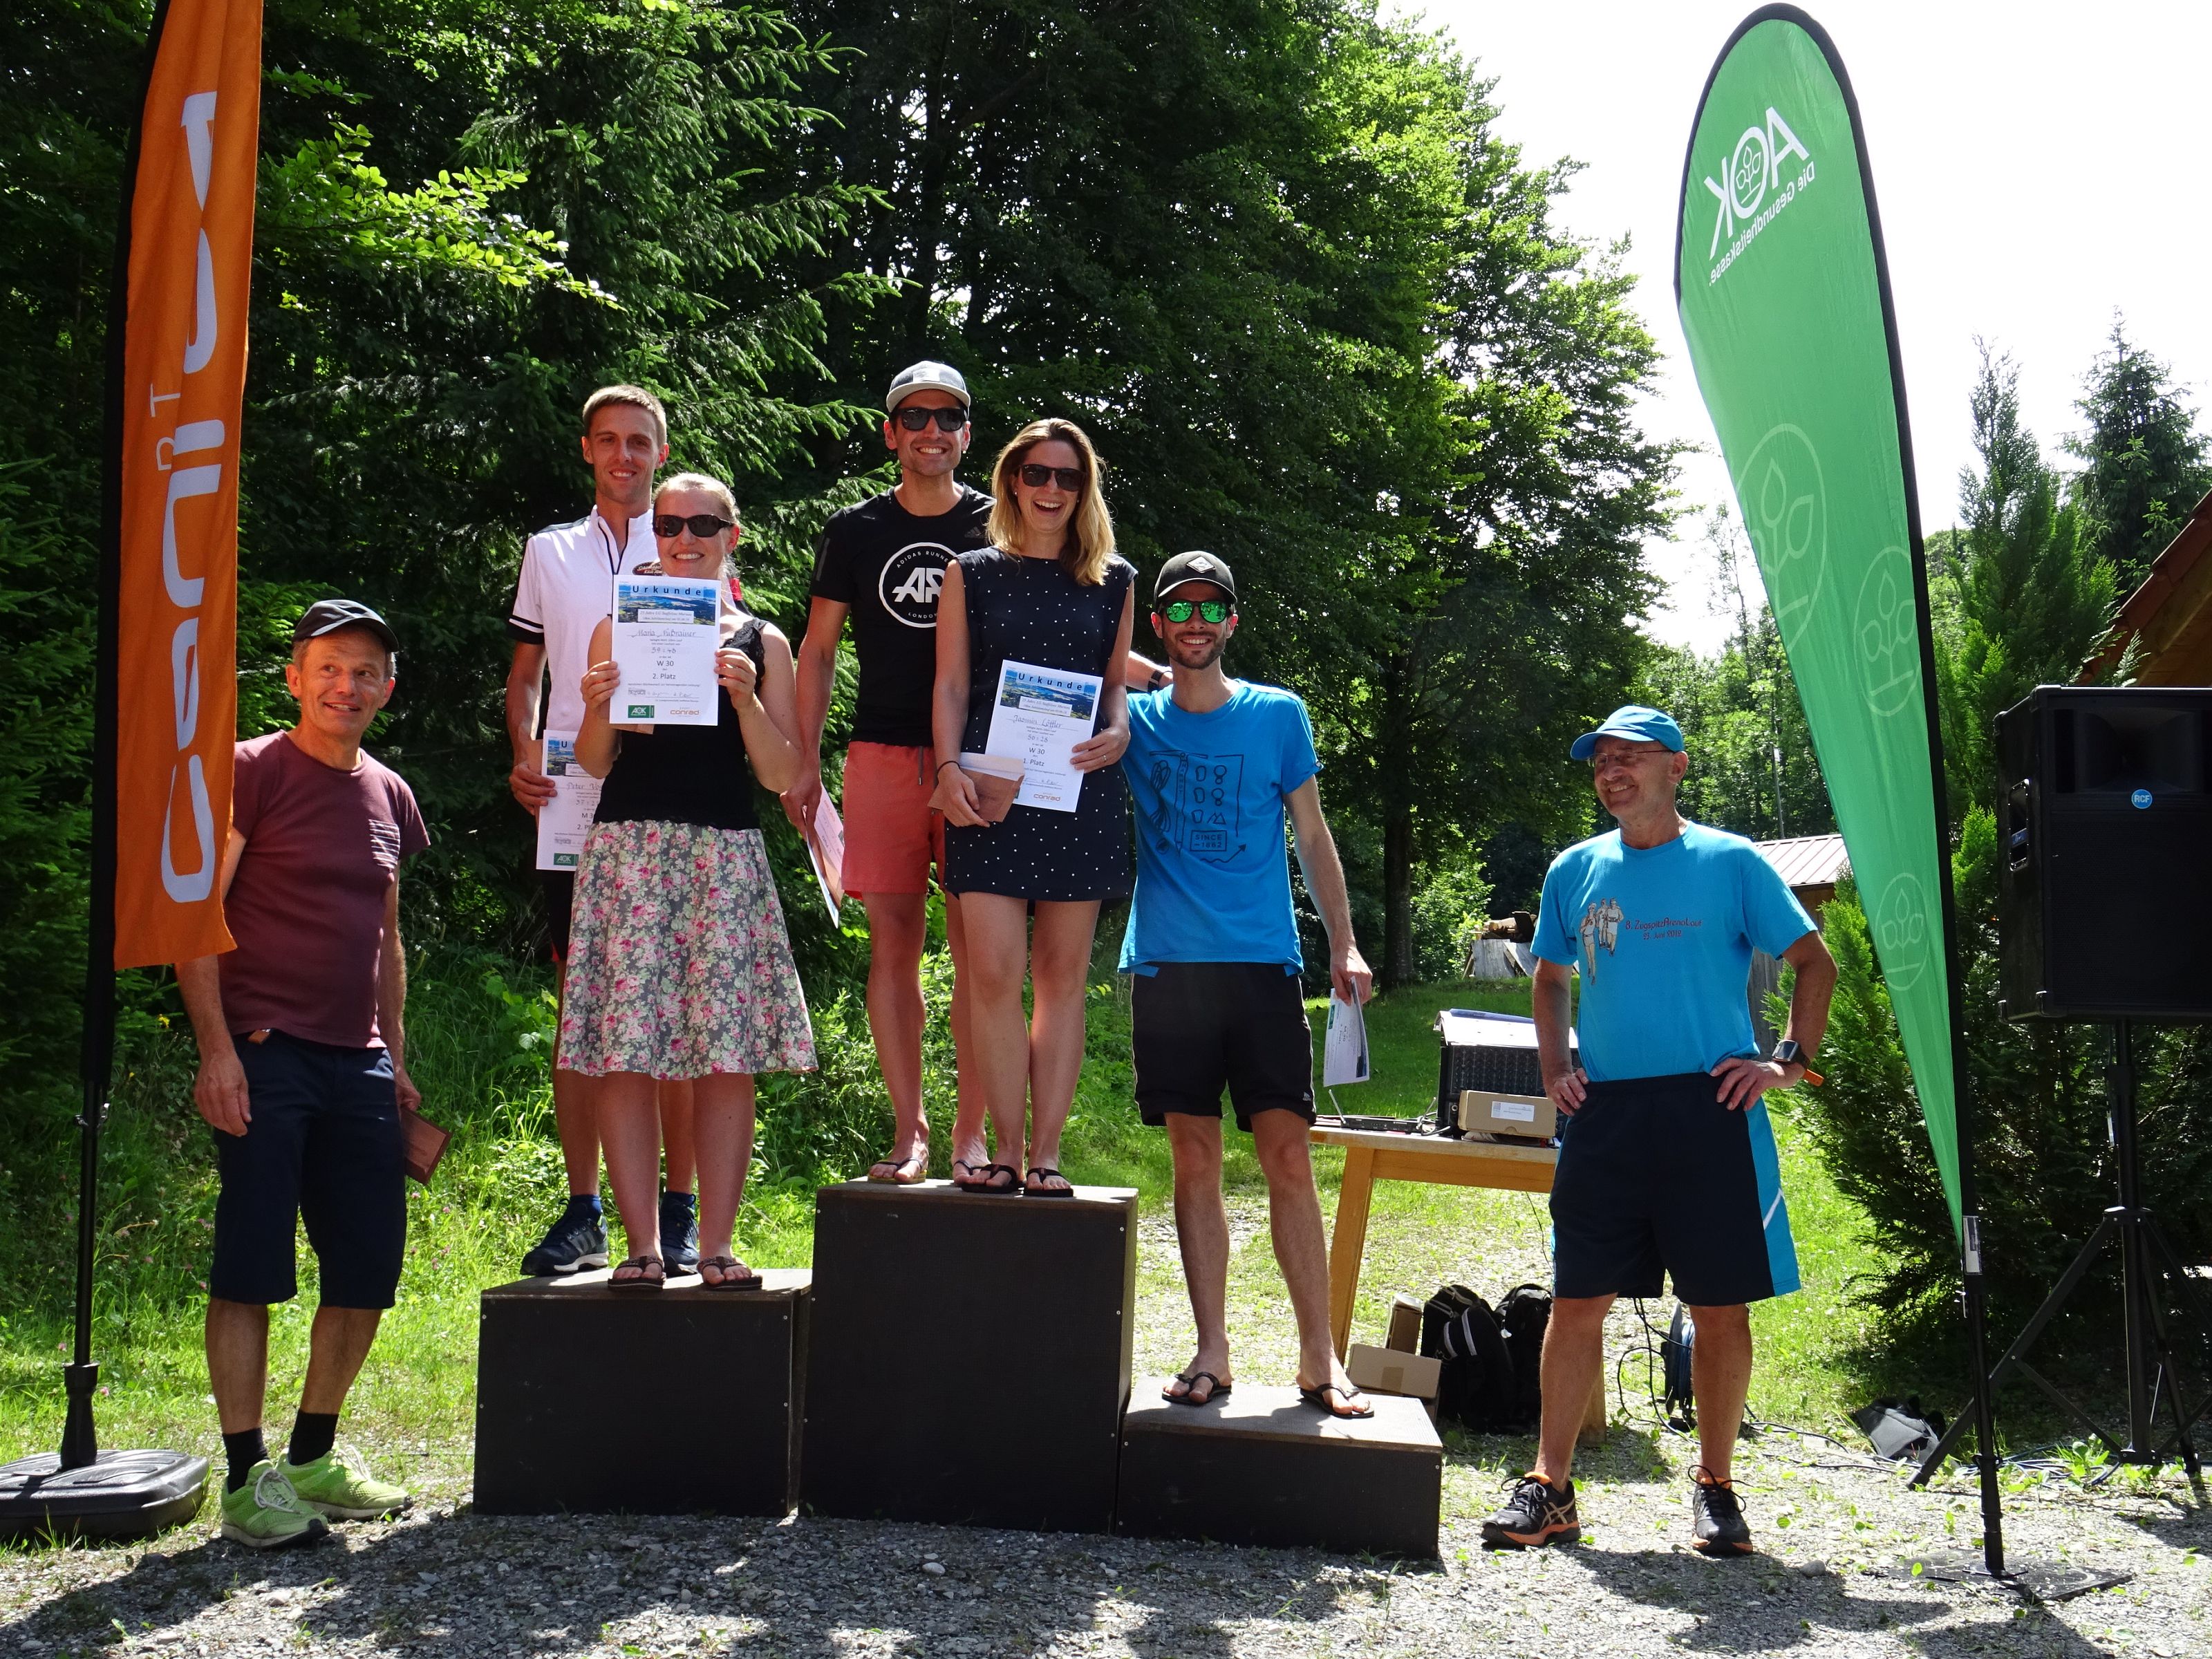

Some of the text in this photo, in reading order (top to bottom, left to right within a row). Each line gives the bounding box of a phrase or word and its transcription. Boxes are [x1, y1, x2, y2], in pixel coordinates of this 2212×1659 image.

[896, 550, 949, 568] ADIDAS RUNNE
[632, 585, 702, 597] Urkunde
[892, 567, 945, 603] AR
[1018, 672, 1082, 691] Urkunde
[1033, 794, 1061, 802] conrad
[2134, 794, 2150, 803] RCF
